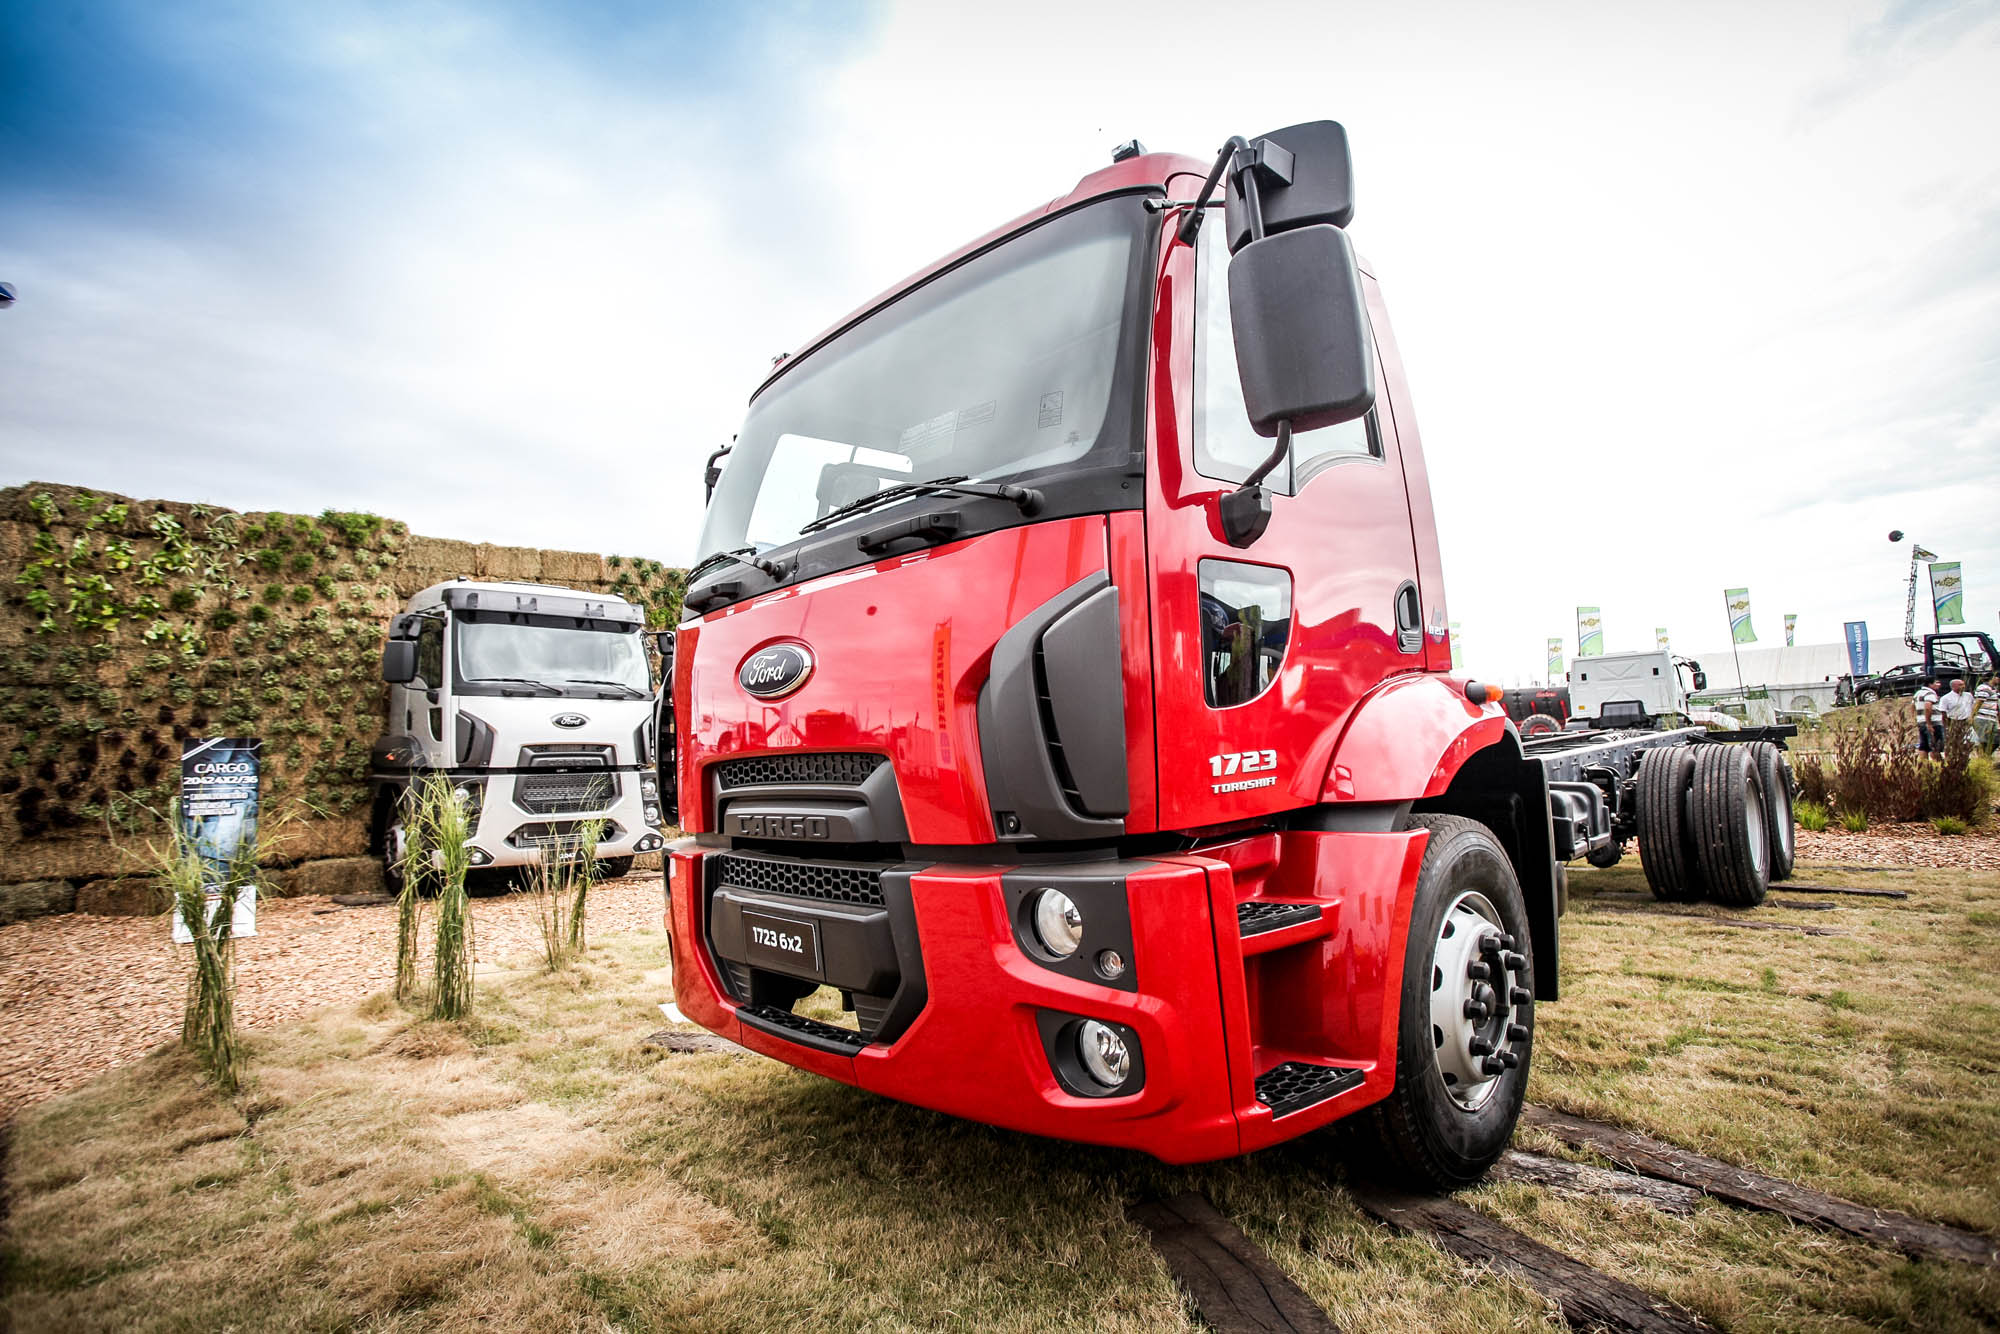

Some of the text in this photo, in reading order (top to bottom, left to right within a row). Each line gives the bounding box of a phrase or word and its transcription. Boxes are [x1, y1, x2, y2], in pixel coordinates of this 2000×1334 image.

[748, 653, 787, 686] Ford
[560, 716, 582, 725] Ford
[194, 763, 249, 774] CARGO
[1208, 749, 1278, 777] 1723
[1211, 776, 1278, 794] TORQSHIFT
[737, 815, 829, 839] CARGO
[752, 926, 803, 953] 1723 6x2
